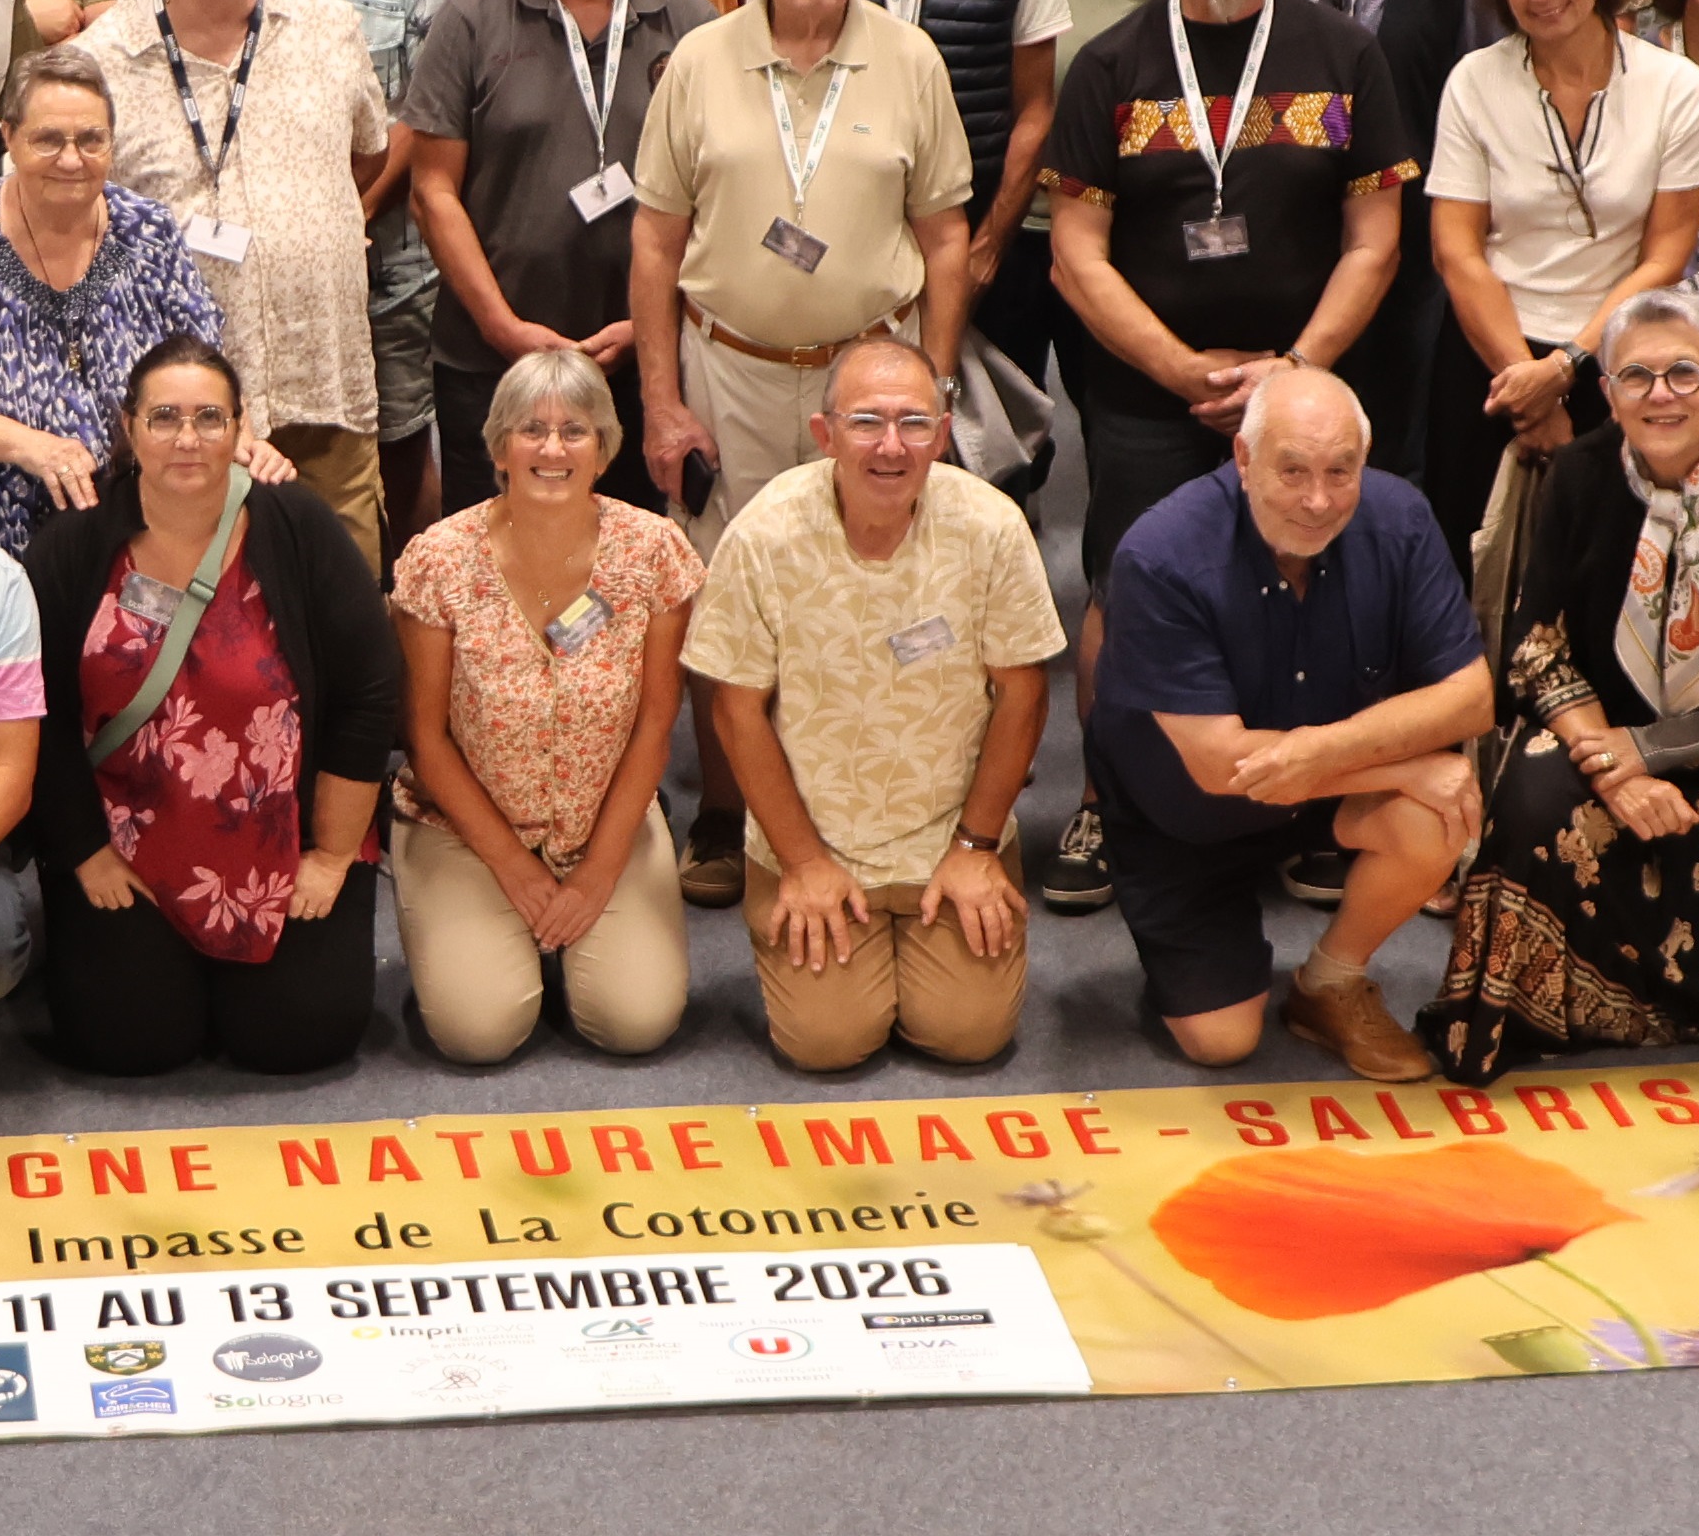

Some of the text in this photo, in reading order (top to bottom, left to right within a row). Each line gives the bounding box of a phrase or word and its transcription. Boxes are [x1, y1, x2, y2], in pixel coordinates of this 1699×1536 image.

[278, 1120, 723, 1188] NATURE
[756, 1106, 1122, 1168] IMAGE
[27, 1225, 305, 1270] Impasse
[354, 1211, 433, 1251] de
[478, 1207, 561, 1246] La
[602, 1191, 979, 1240] Cotonnerie
[2, 1293, 57, 1335] 11
[97, 1286, 187, 1329] AU
[218, 1282, 295, 1324] 13
[327, 1264, 737, 1321] SEPTEMBRE
[765, 1256, 953, 1303] 2026
[938, 1312, 984, 1322] 2000
[390, 1323, 534, 1340] Imprinova
[748, 1336, 793, 1355] U
[881, 1339, 957, 1350] FDVA
[213, 1392, 344, 1408] Sologne
